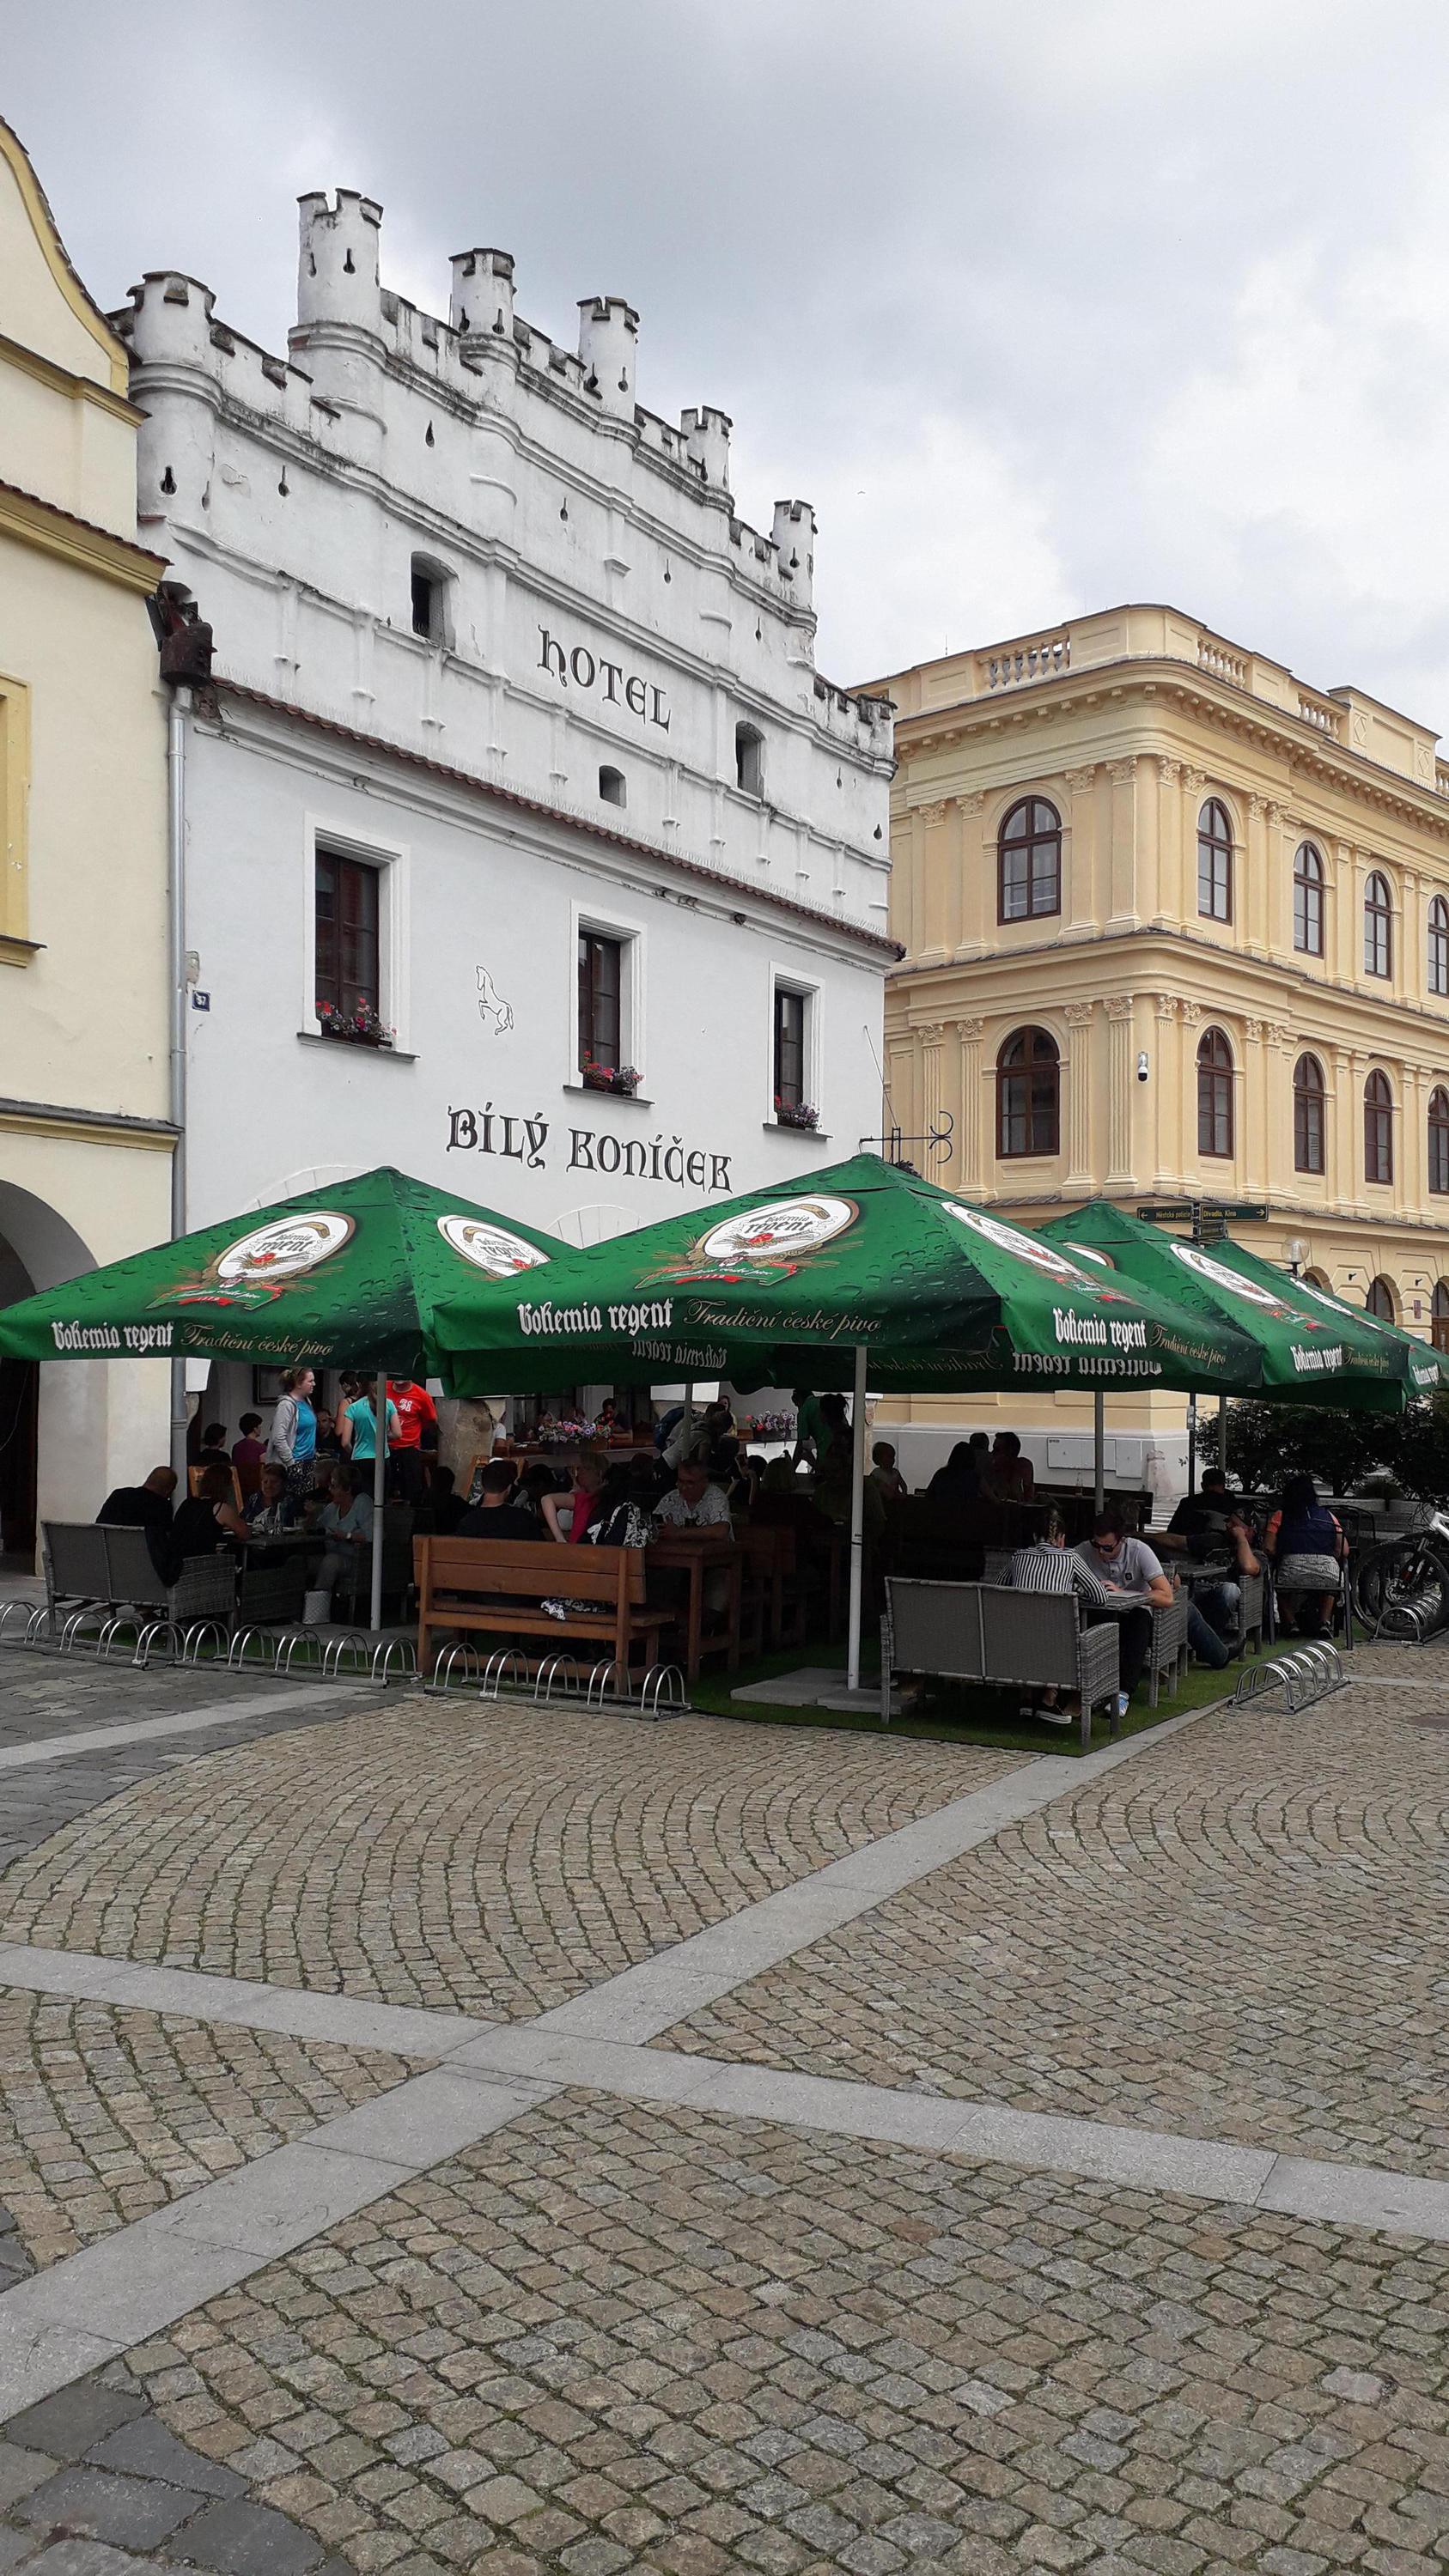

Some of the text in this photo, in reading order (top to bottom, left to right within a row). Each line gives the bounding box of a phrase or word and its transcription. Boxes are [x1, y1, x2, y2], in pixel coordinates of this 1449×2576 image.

[537, 624, 672, 734] HOTEL
[446, 1102, 733, 1194] BÍLÝ KONÍČEK
[51, 1320, 334, 1362] Bohemia regent Tradiční české pivo
[517, 1297, 881, 1340] Bohemia regent Tradiční české pivo
[1053, 1306, 1107, 1346] Bohemia
[1110, 1320, 1147, 1352] regent
